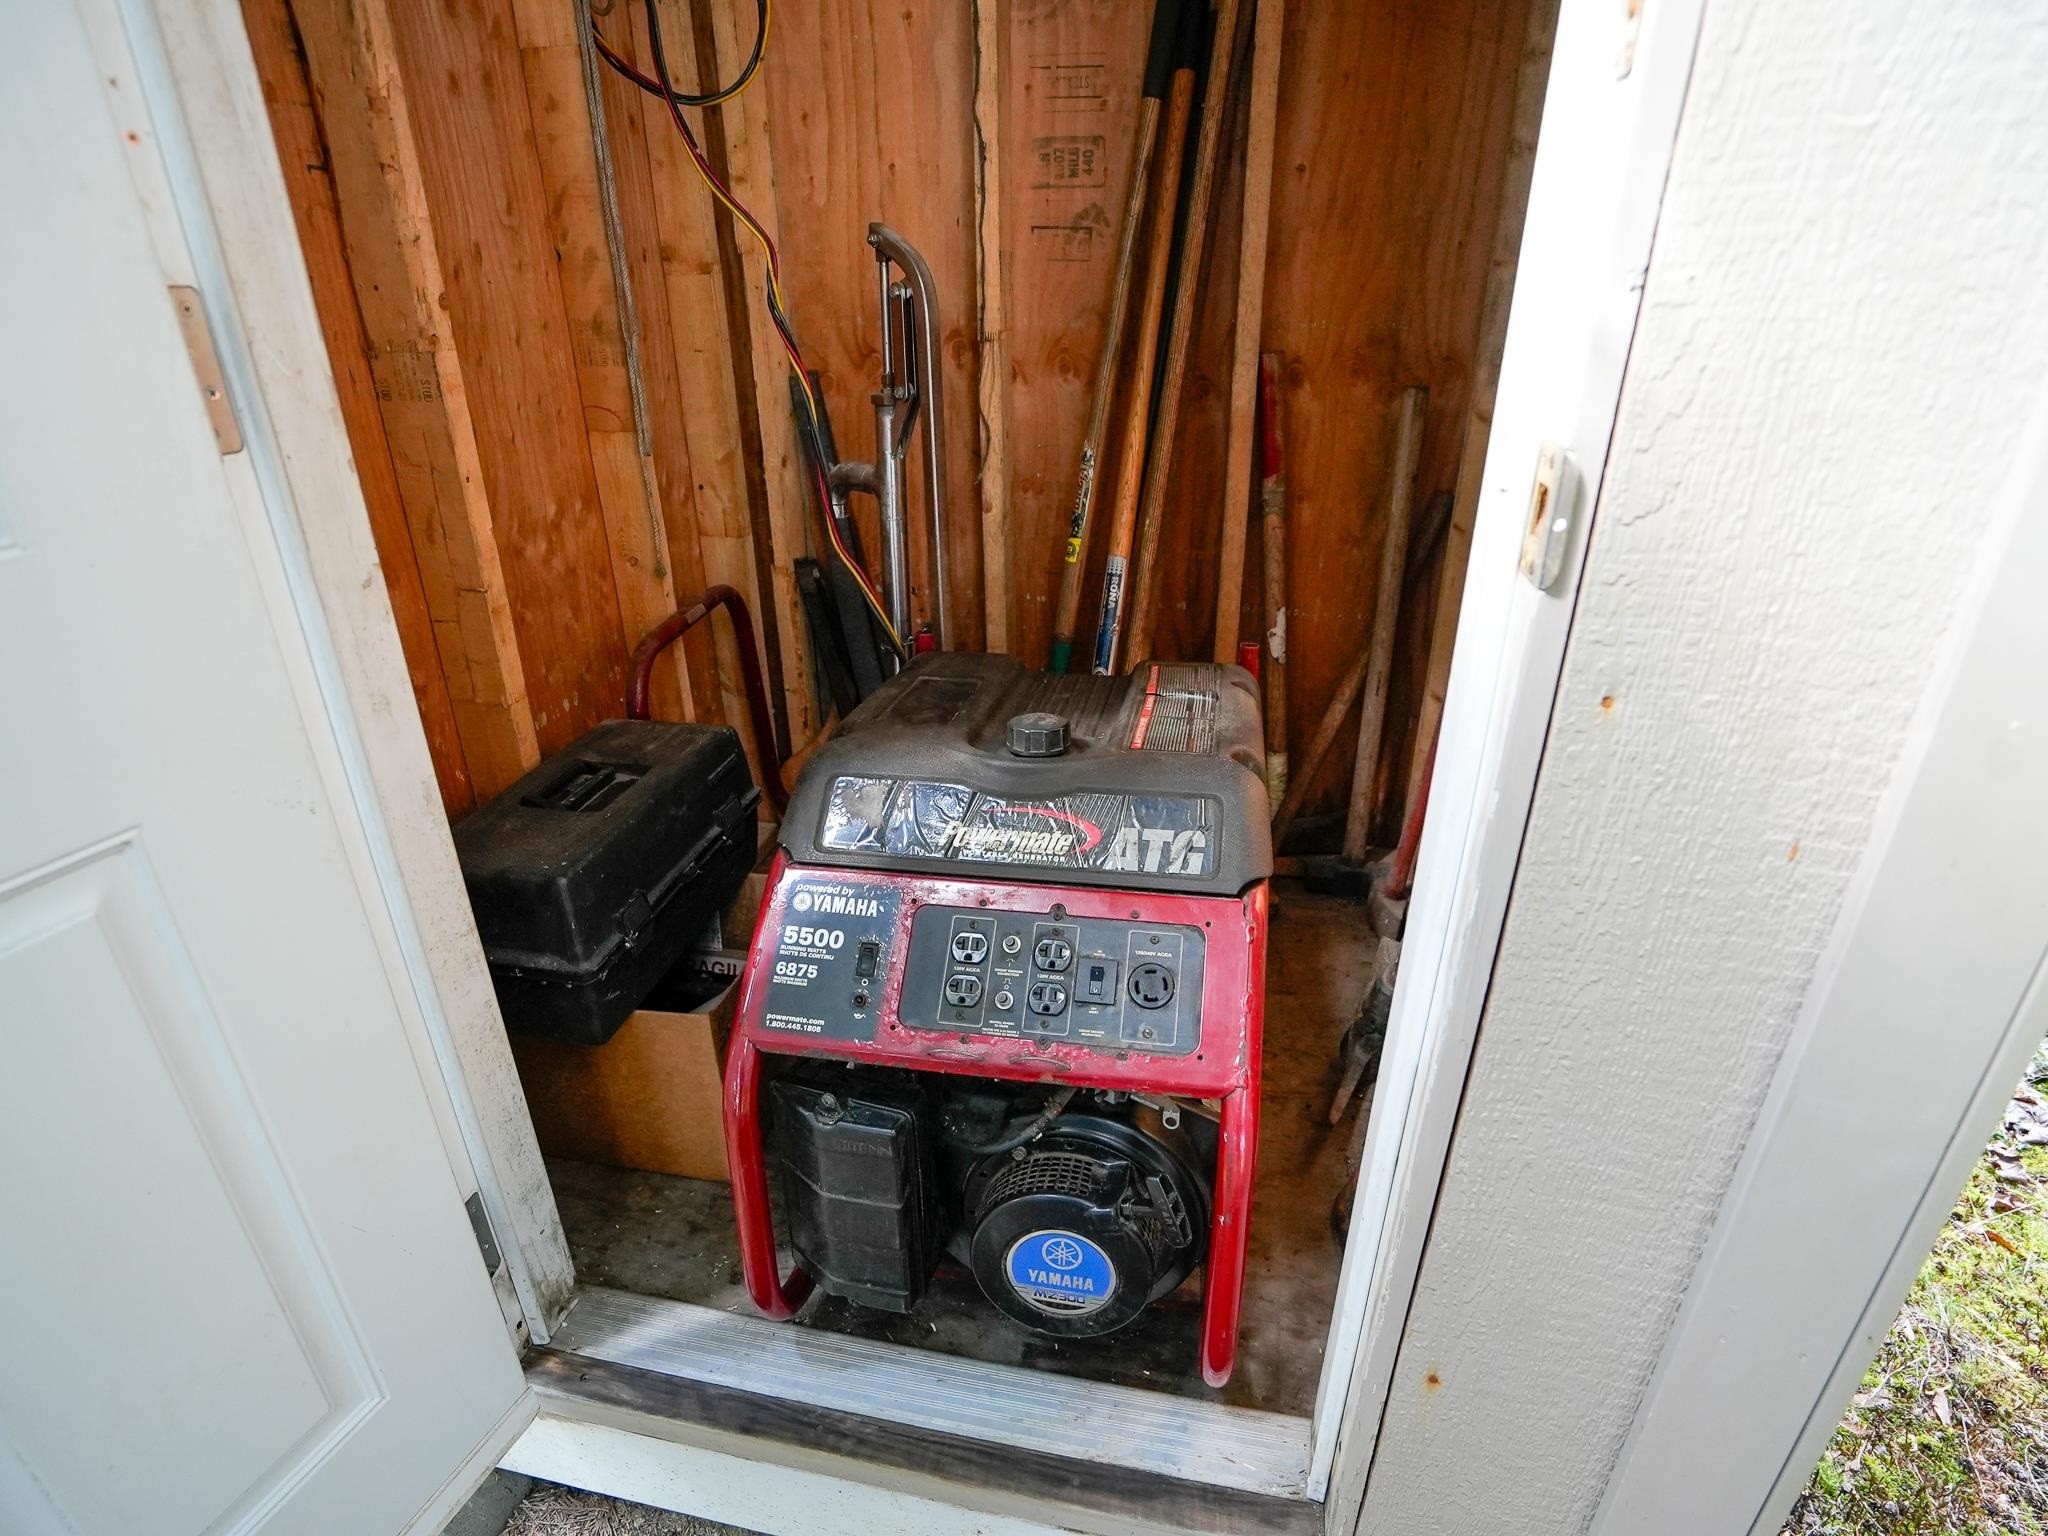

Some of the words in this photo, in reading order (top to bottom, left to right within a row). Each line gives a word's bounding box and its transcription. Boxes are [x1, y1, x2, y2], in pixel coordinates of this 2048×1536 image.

[420, 379, 434, 403] STUD
[939, 820, 1074, 854] Powermate
[1012, 853, 1067, 863] GENERATOR
[795, 883, 841, 895] powered
[841, 886, 856, 897] by
[813, 894, 878, 917] YAMAHA
[783, 925, 845, 949] 5500
[776, 961, 818, 978] 6875
[766, 1013, 825, 1026] powermate.com
[766, 1020, 821, 1033] 1.800.445.1805
[1028, 1269, 1094, 1292] YAMAHA
[1033, 1287, 1086, 1305] MZ300
